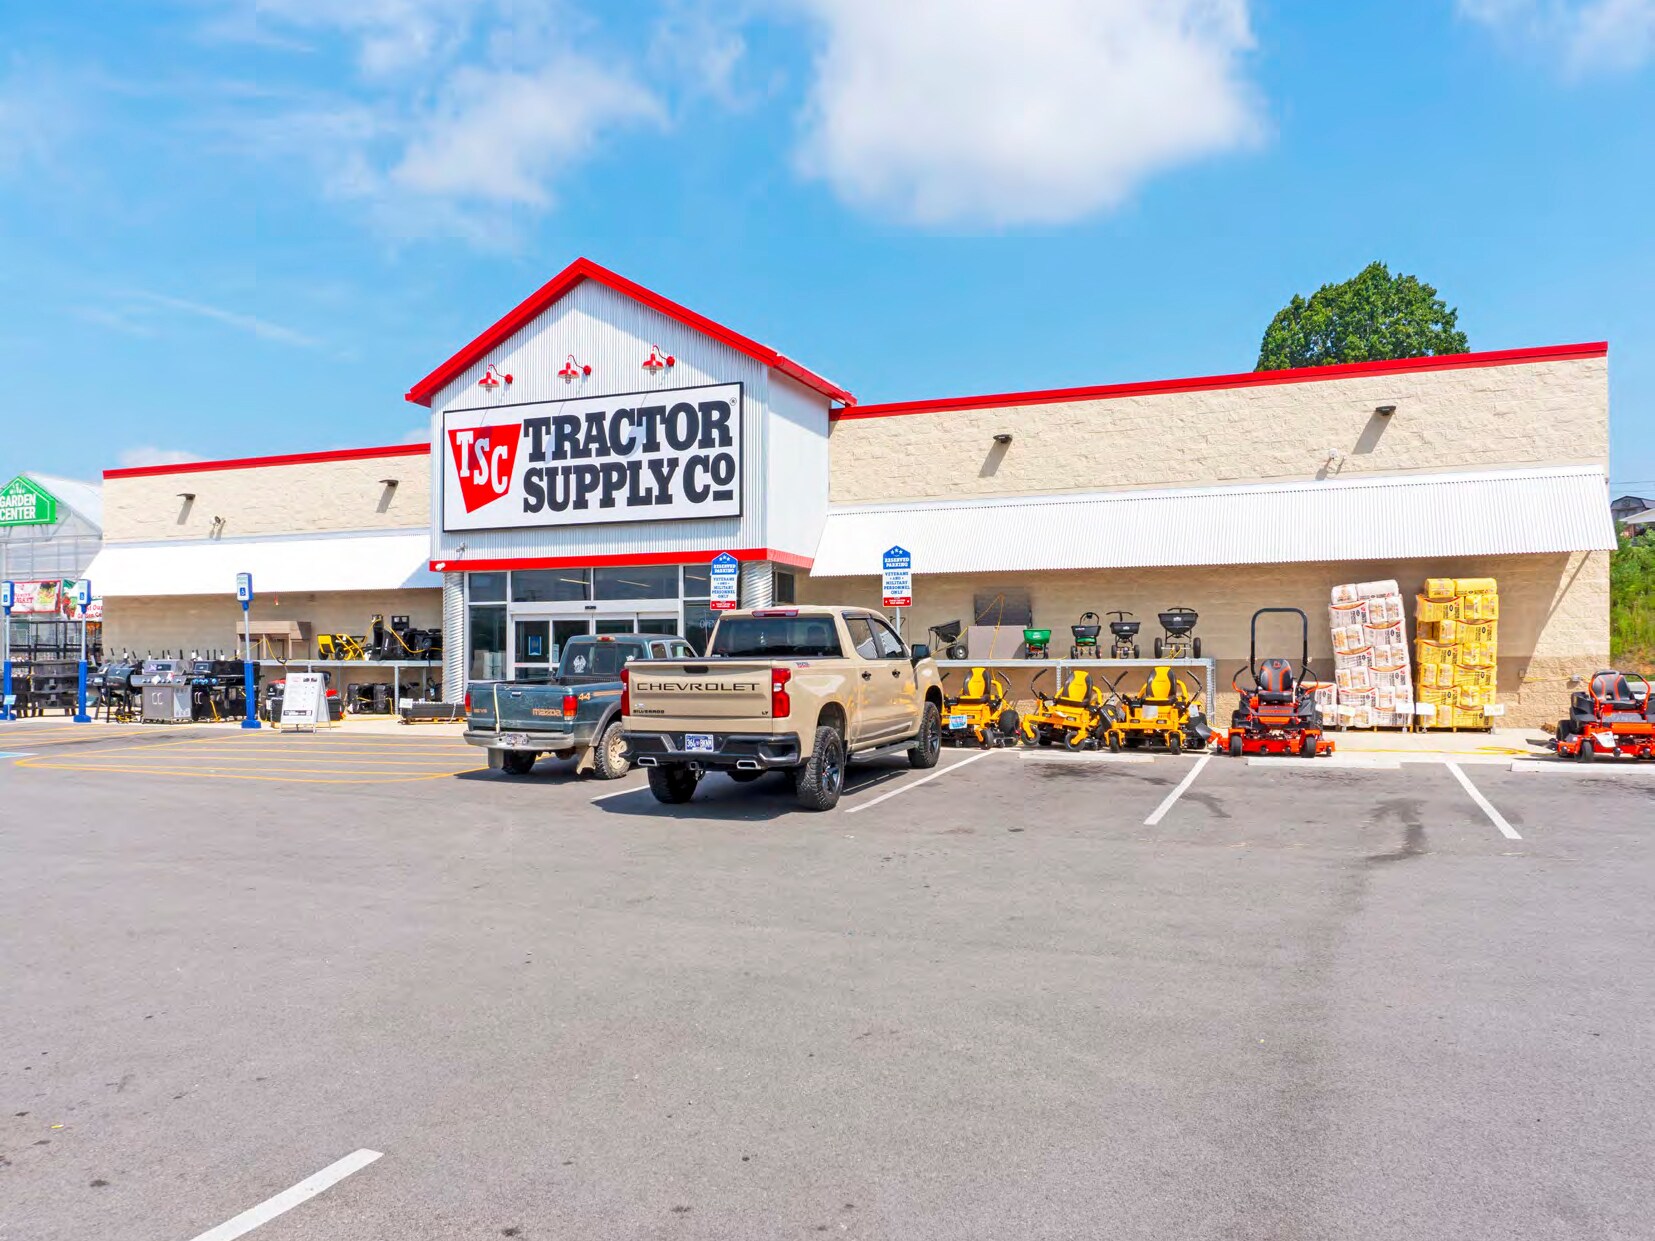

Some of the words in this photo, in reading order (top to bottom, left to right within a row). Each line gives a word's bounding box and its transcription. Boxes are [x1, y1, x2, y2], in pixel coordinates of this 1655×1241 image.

[523, 400, 733, 463] TRACTOR
[456, 430, 508, 495] TSC
[0, 494, 36, 507] GARDEN
[523, 456, 679, 513] SUPPLY
[0, 506, 36, 520] CENTER
[636, 682, 760, 691] CHEVROLET
